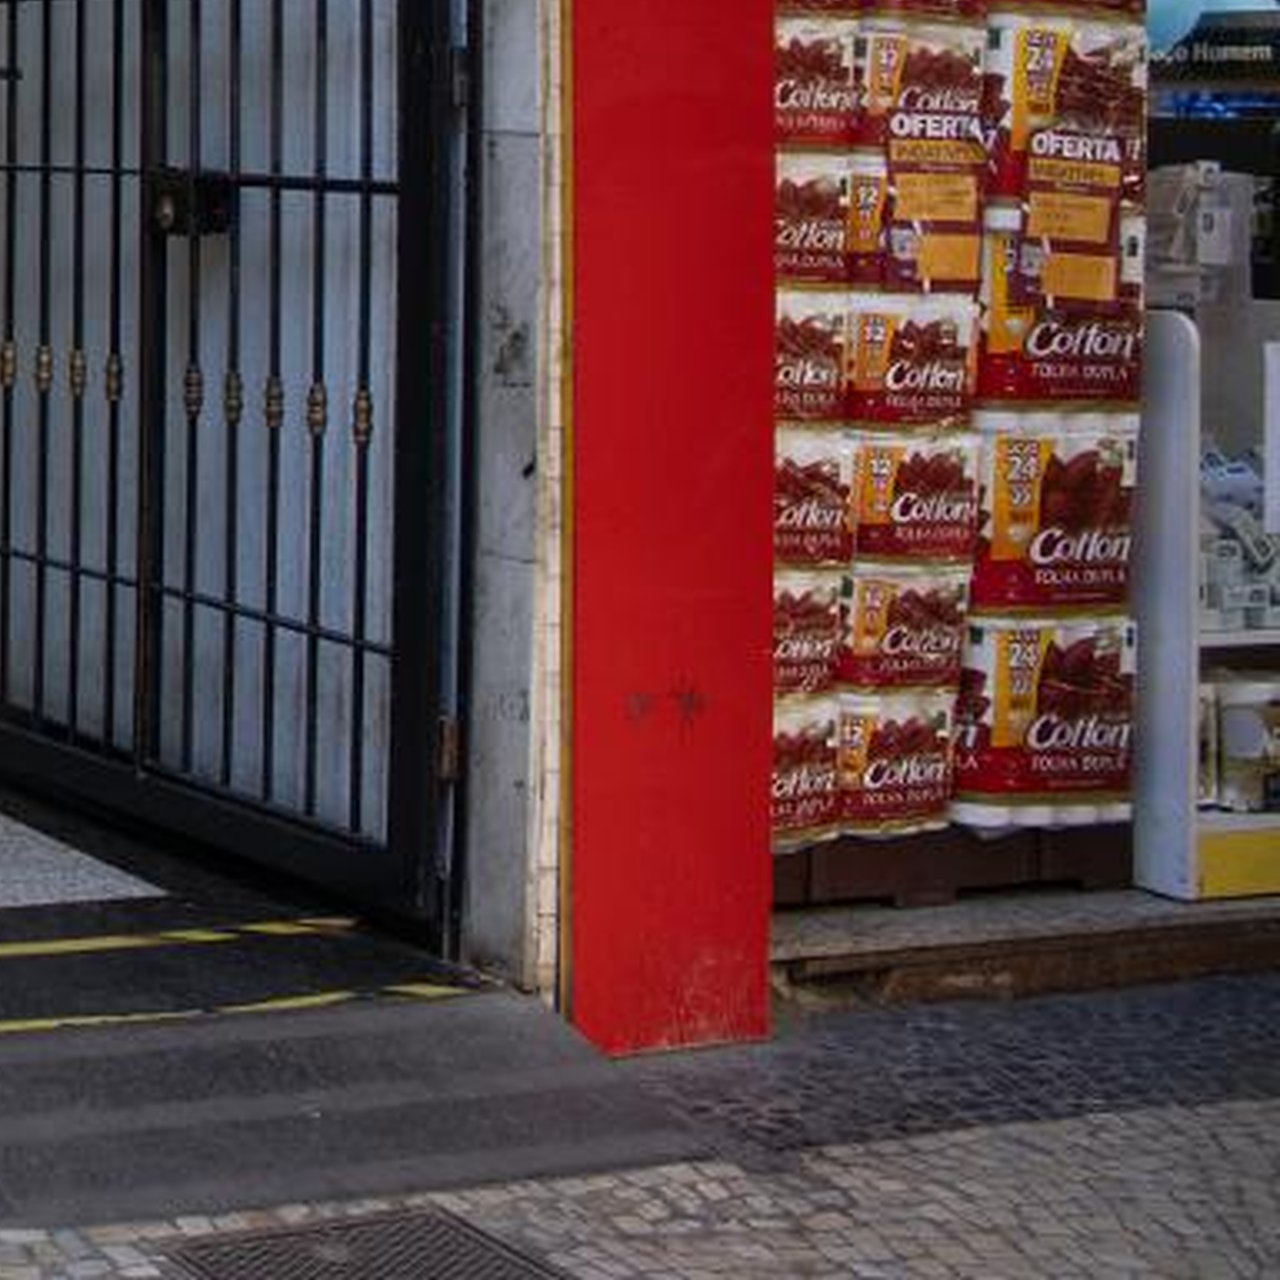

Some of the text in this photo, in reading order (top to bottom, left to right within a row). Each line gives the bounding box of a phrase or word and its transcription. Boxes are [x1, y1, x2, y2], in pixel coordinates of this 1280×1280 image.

[898, 85, 980, 112] Cotton
[891, 112, 983, 142] OFERTA
[1030, 131, 1122, 163] OFERTA
[1025, 321, 1133, 359] Cotton
[885, 360, 965, 400] Cotton
[892, 491, 972, 524] Cotton
[1029, 527, 1132, 565] Cotton
[1026, 714, 1129, 750] Cotton
[862, 756, 945, 789] Cotton
